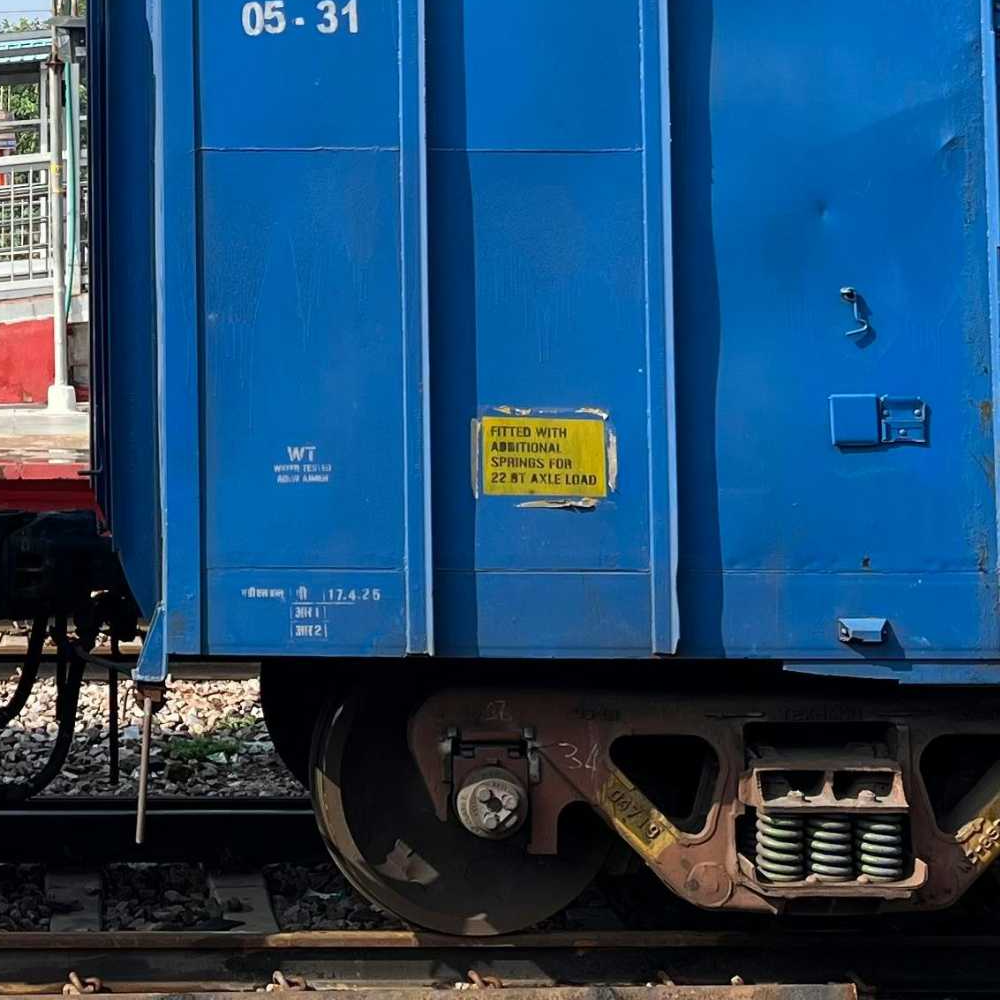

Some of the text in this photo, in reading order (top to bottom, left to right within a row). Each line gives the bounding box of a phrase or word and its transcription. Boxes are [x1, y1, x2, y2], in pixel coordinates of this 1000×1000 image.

[491, 426, 567, 438] FITTED WITH
[491, 441, 561, 453] ADDITIONAL
[288, 447, 315, 461] WT
[492, 456, 572, 469] SPRINGS FOR
[531, 473, 560, 484] AXLE
[566, 474, 596, 485] LOAD
